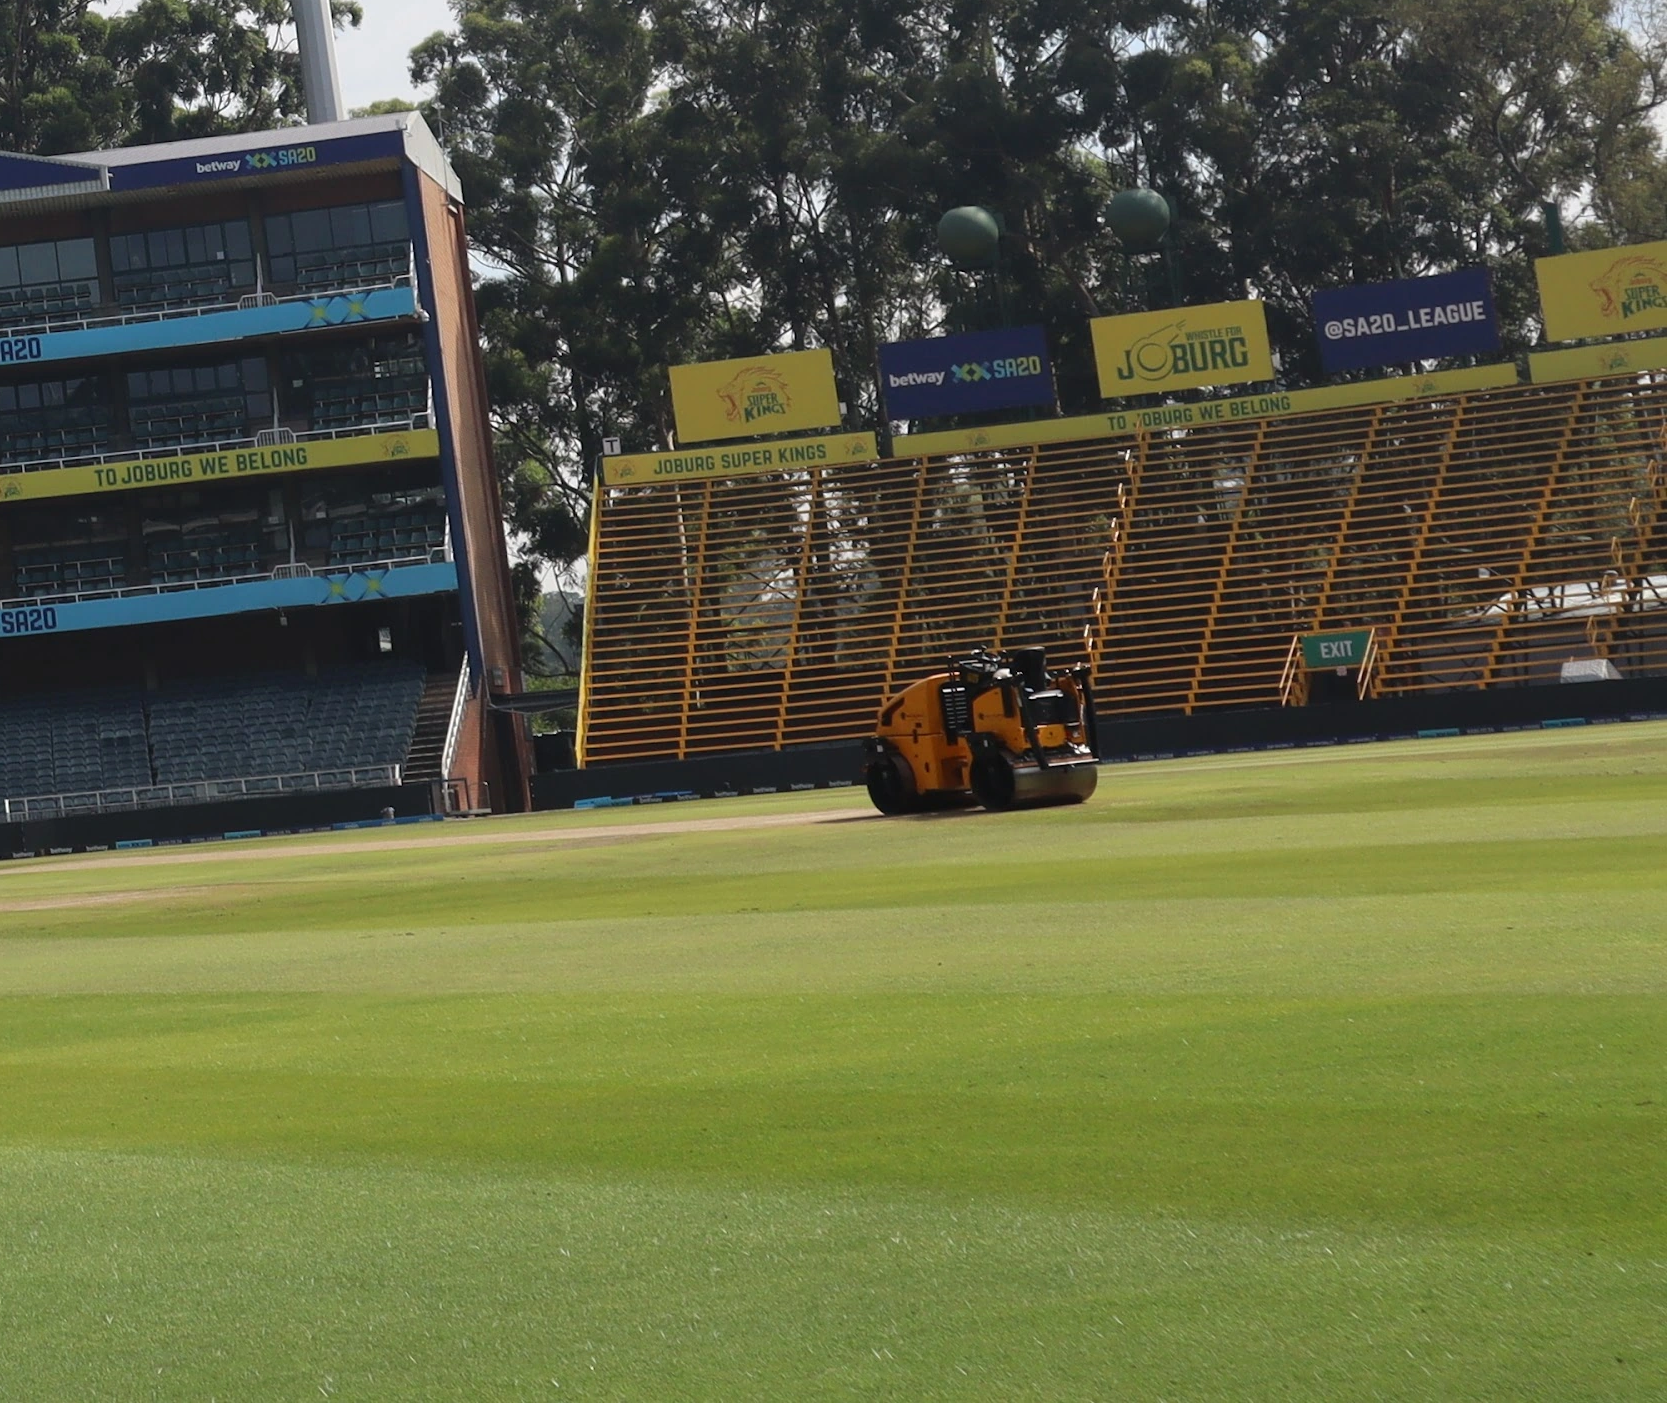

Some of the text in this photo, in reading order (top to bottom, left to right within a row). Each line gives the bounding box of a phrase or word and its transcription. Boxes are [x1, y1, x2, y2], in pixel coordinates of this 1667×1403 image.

[196, 147, 316, 175] betway SA20
[1185, 326, 1242, 341] WHISTLE FOR
[1325, 301, 1486, 339] @SA20_LEAGUE
[889, 356, 1041, 387] betway SA20
[1107, 415, 1126, 431] TO
[1199, 404, 1225, 420] WE
[1229, 396, 1291, 417] BELONG
[94, 447, 307, 487] TO JOBURG WE BELONG
[654, 444, 826, 475] JOBURG SUPER KINGS
[1, 607, 57, 634] SA20
[1320, 640, 1352, 658] EXIT
